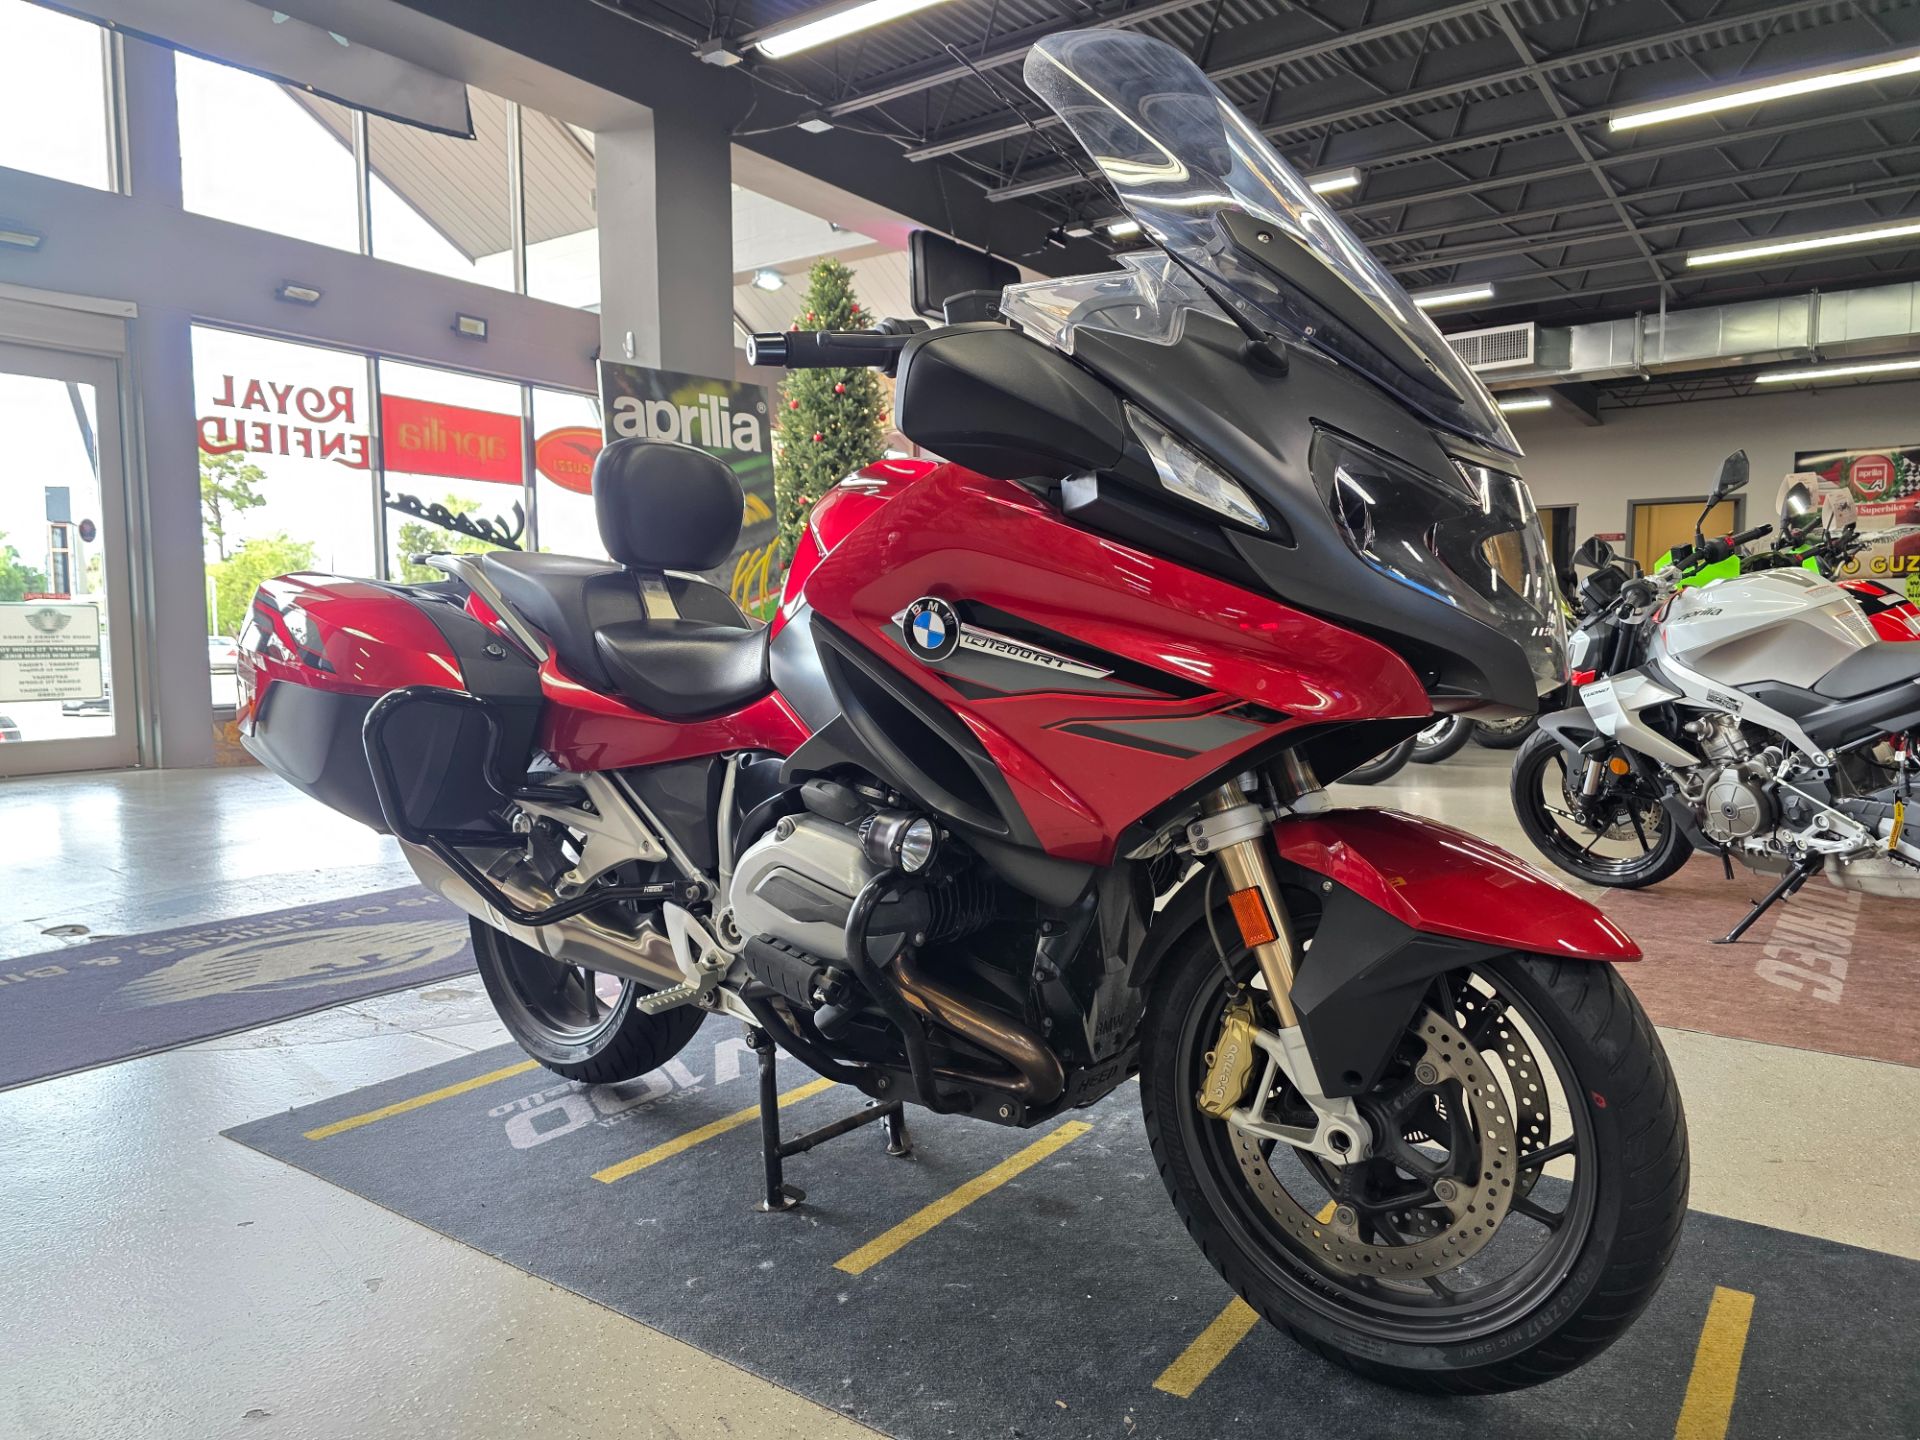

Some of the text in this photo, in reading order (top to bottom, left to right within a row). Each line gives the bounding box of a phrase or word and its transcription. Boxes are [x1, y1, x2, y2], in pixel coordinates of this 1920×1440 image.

[612, 393, 762, 453] aprilia
[1858, 469, 1883, 479] aprilia
[1860, 504, 1907, 516] Superbikes
[911, 600, 954, 626] BMW
[333, 906, 390, 921] OF
[137, 919, 326, 956] TRIKES
[1753, 884, 1863, 1005] TUAREG
[79, 955, 122, 967] &
[1096, 1012, 1126, 1037] BMW
[1213, 1043, 1239, 1100] brembo
[595, 1104, 655, 1130] GUZZI
[1527, 1307, 1562, 1338] ZR17
